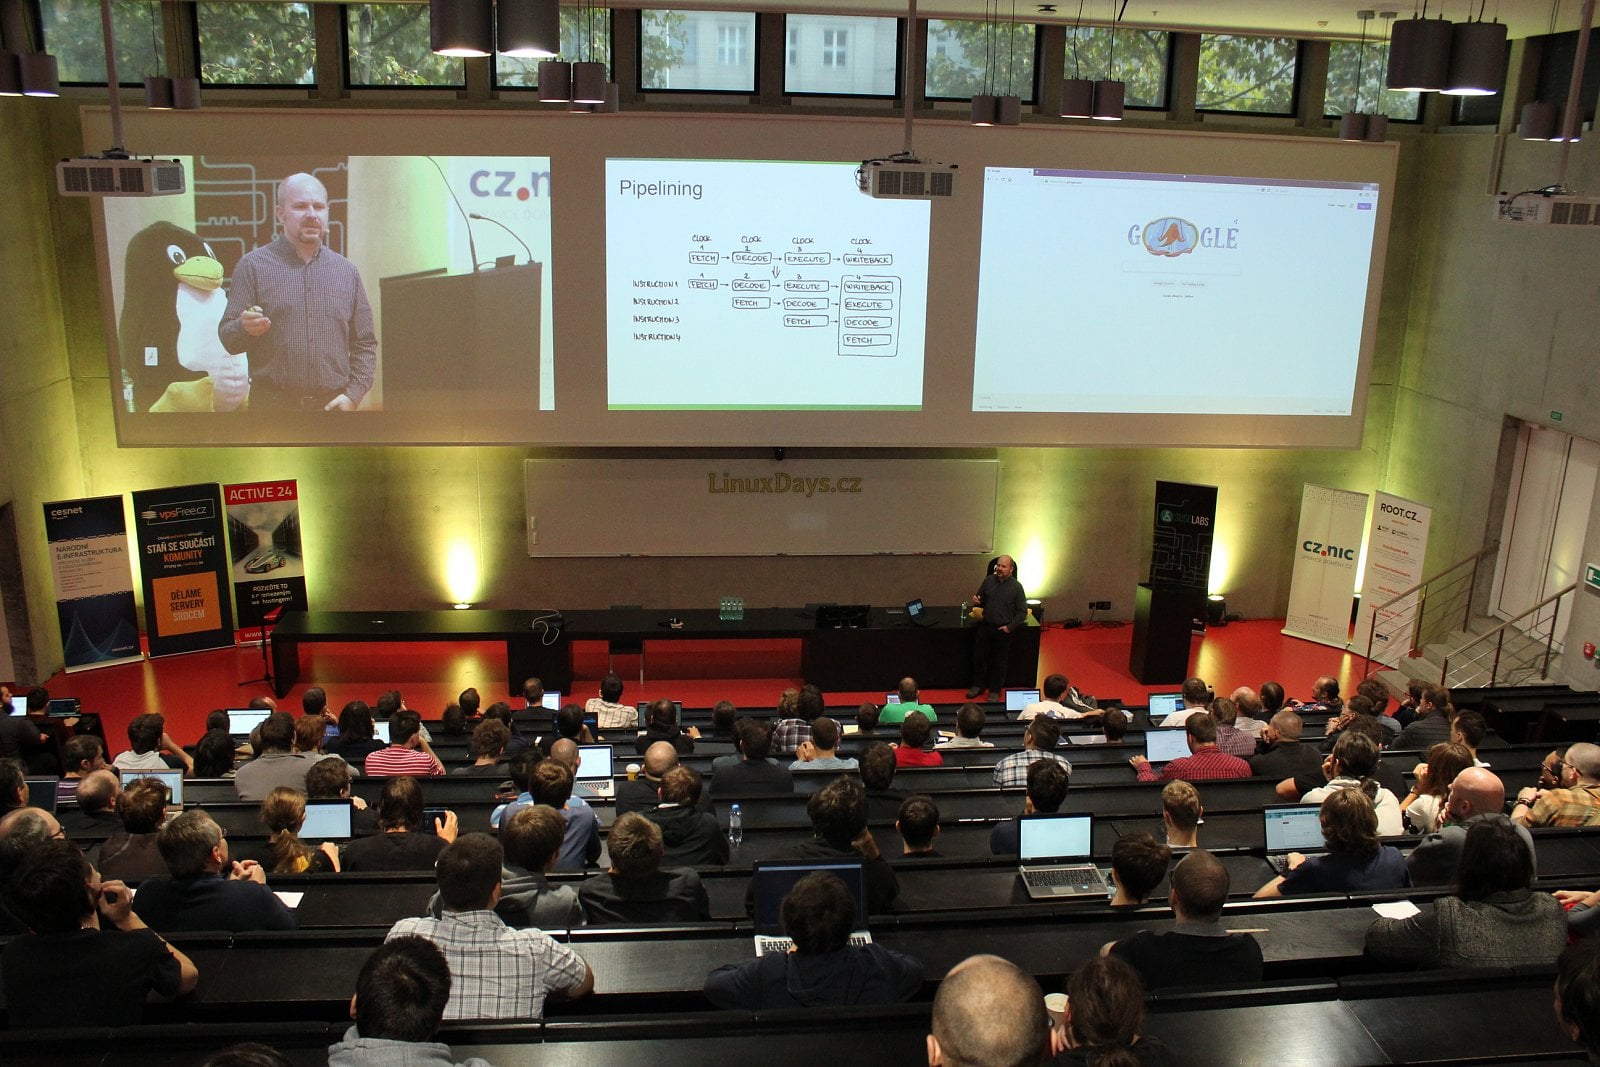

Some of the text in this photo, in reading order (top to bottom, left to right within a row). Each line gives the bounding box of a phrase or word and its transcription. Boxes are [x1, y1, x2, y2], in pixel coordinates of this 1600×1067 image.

[620, 179, 703, 200] Pipelining
[786, 282, 820, 290] EXECUTE
[846, 283, 890, 291] WRITEBACK
[786, 317, 811, 325] FETCH
[708, 472, 862, 498] LinuxDays.cz
[230, 486, 293, 500] ACTIVE 24
[51, 506, 83, 516] cesnet
[168, 542, 178, 551] SE
[163, 549, 203, 563] KOMUNITY
[170, 599, 204, 612] SERVERY
[173, 609, 205, 622] SRDCEM
